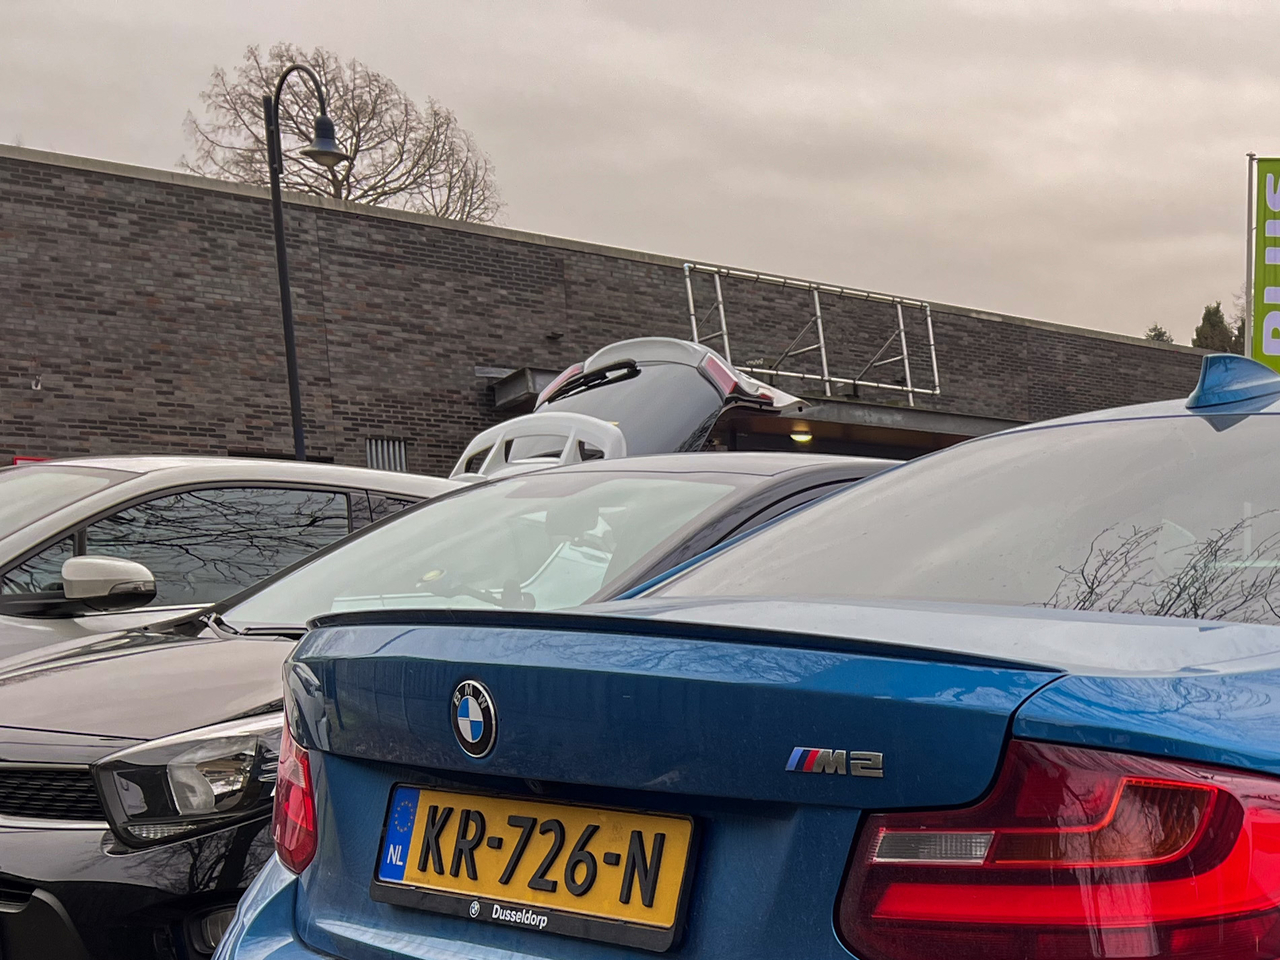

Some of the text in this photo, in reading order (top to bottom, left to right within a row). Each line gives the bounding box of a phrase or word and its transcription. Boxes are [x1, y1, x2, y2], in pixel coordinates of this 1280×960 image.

[453, 683, 489, 709] BMW
[809, 747, 884, 778] M2
[386, 843, 404, 867] NL
[417, 804, 666, 909] KR-726-N
[491, 904, 548, 929] Dusseldorp
